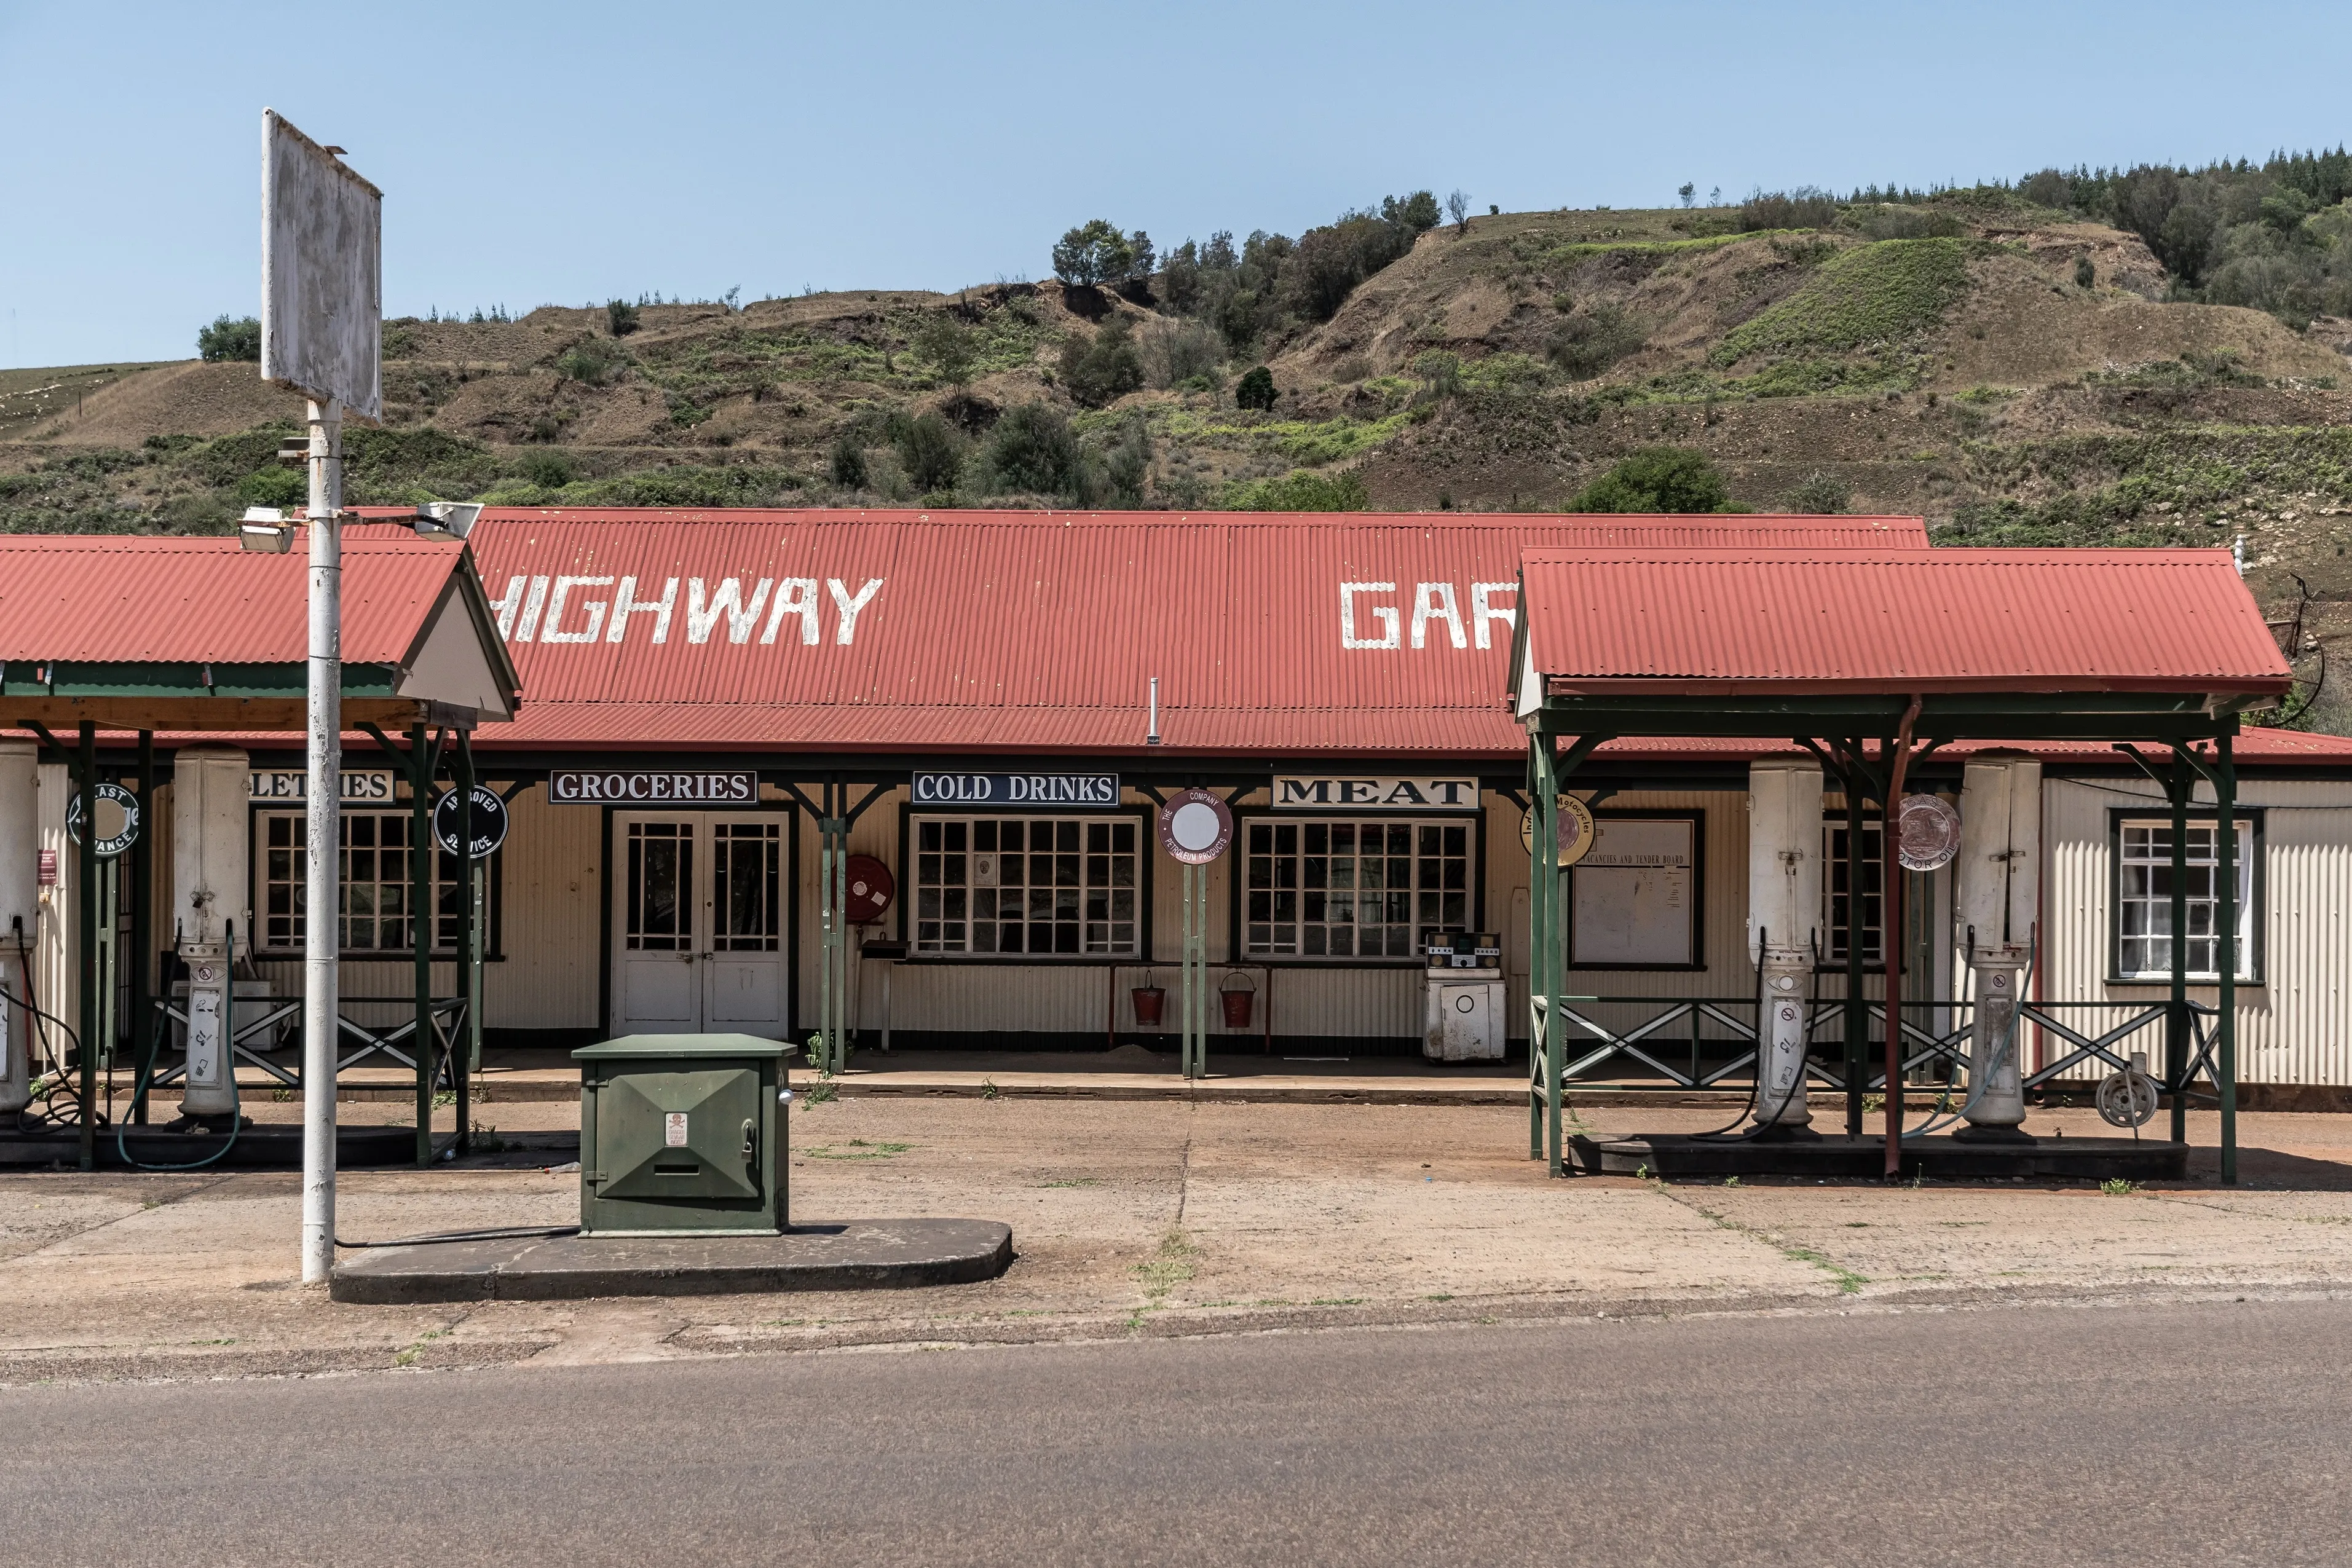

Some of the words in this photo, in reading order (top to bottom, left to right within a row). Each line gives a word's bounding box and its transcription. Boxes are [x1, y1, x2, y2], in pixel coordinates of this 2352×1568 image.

[1340, 581, 1520, 650] GAR
[557, 774, 749, 799] GROCERIES
[918, 775, 992, 800] COLD
[1009, 776, 1113, 802] DRINKS
[1279, 779, 1475, 805] MEAT
[1162, 808, 1173, 821] THE
[1190, 792, 1220, 806] COMPANY
[1907, 797, 1938, 807] GAS
[1557, 797, 1590, 833] Motocycles
[95, 832, 132, 851] ANCE
[1165, 838, 1196, 861] PETROLEUM
[1199, 837, 1227, 861] PRODUCTS
[1620, 855, 1632, 864] AND
[1636, 855, 1660, 864] TENDER
[1663, 855, 1684, 864] BOARD
[1899, 852, 1933, 869] OTOR
[1939, 845, 1957, 862] OIL
